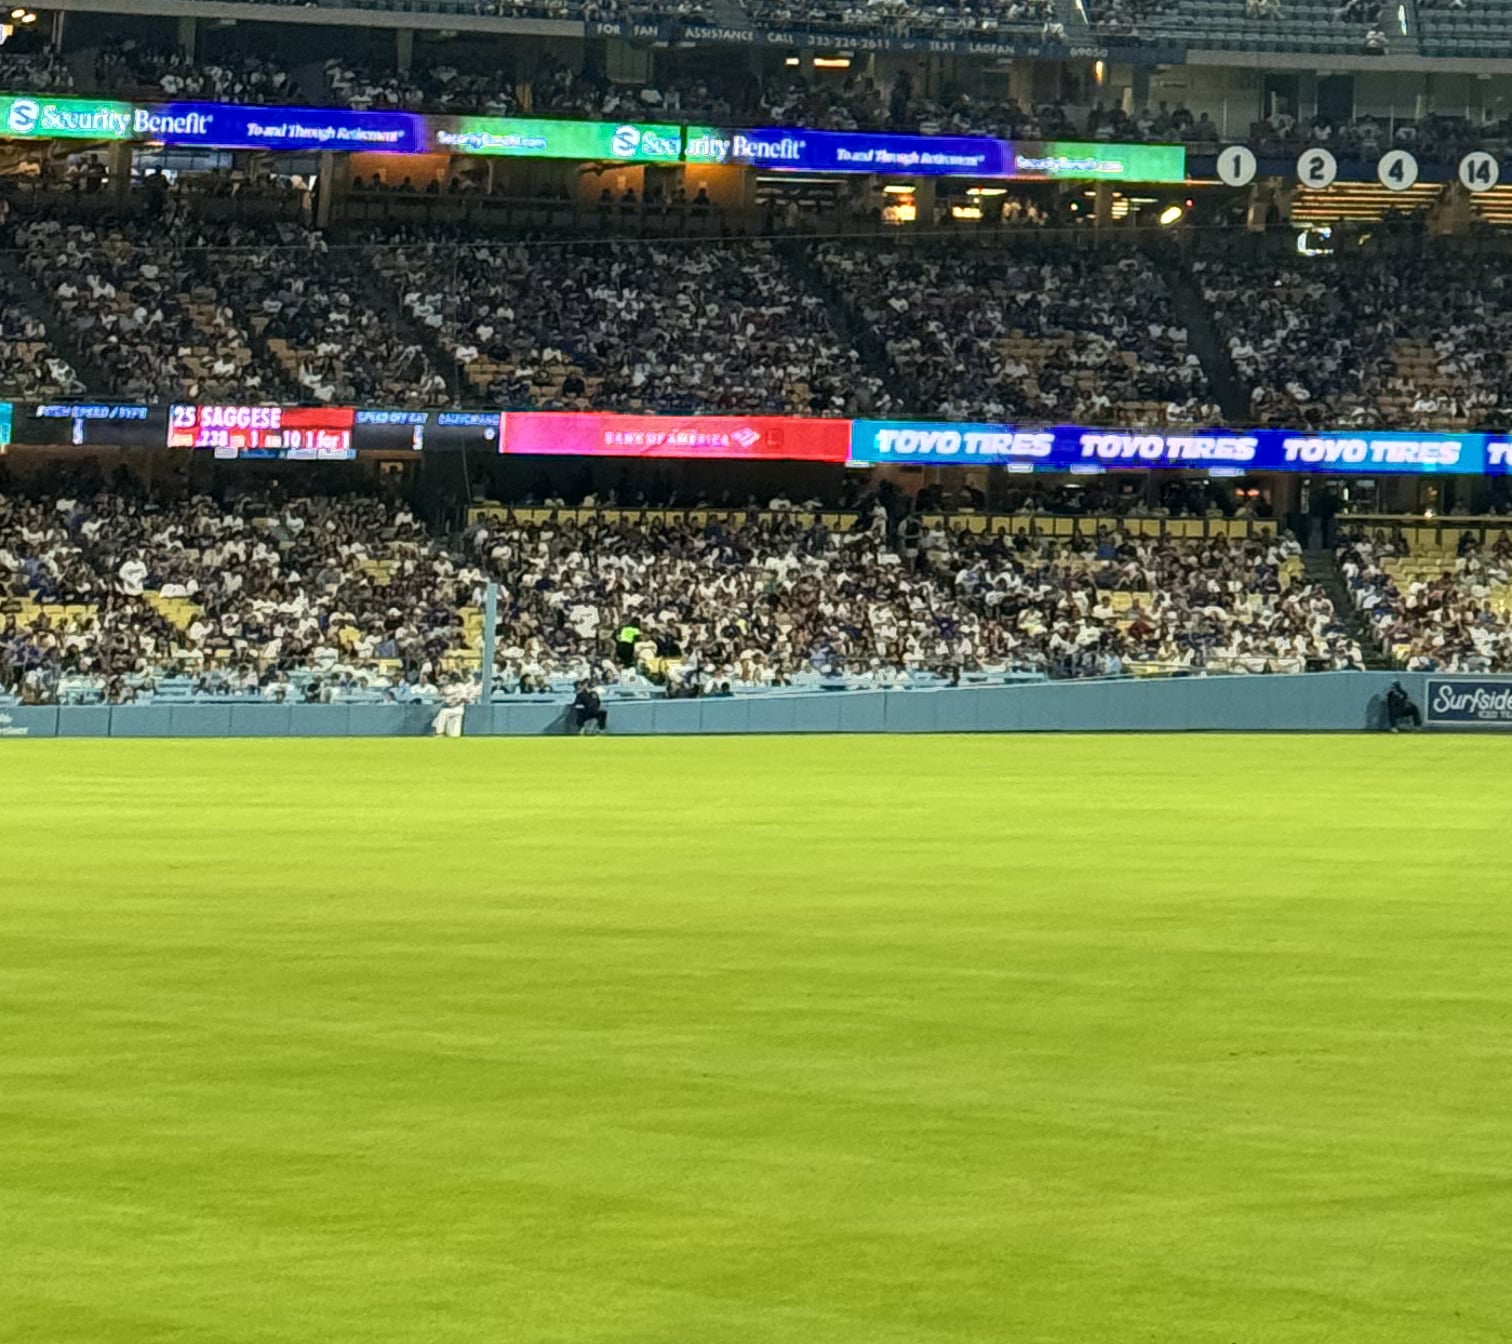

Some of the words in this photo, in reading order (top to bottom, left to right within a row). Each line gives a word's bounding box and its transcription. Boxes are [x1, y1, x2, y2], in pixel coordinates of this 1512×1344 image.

[597, 23, 620, 35] FOR
[685, 27, 754, 41] ASSISTANCE
[767, 32, 793, 44] CALL
[41, 104, 130, 136] Security
[133, 109, 208, 134] Benefit
[732, 135, 800, 160] Benefit
[1233, 154, 1242, 178] 1
[1309, 157, 1325, 180] 2
[1389, 159, 1406, 182] 4
[1468, 160, 1491, 184] 14
[174, 406, 196, 427] 25
[201, 406, 281, 429] SAGGESE
[876, 428, 960, 455] TOYO
[963, 432, 1055, 457] TIRES
[1080, 434, 1163, 459] TOYO
[1165, 436, 1259, 461] TIRES
[1283, 438, 1367, 463] TOYO
[1370, 440, 1462, 465] TIRES
